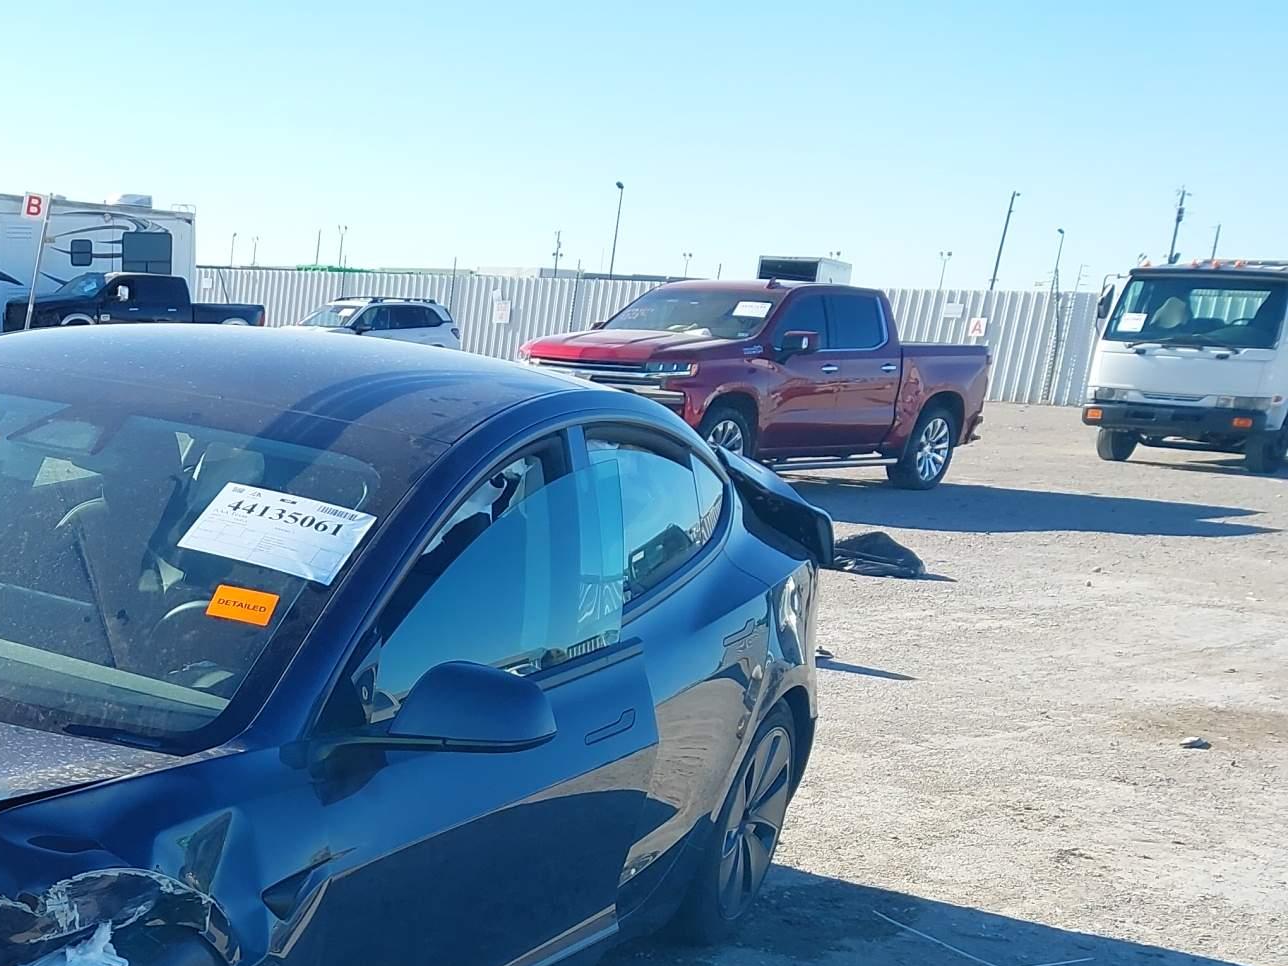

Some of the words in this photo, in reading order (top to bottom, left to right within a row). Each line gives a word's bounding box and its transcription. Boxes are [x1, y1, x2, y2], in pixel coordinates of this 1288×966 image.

[26, 195, 42, 216] B
[971, 320, 982, 334] A
[228, 499, 344, 537] 44135061
[217, 598, 267, 613] DETAILED
